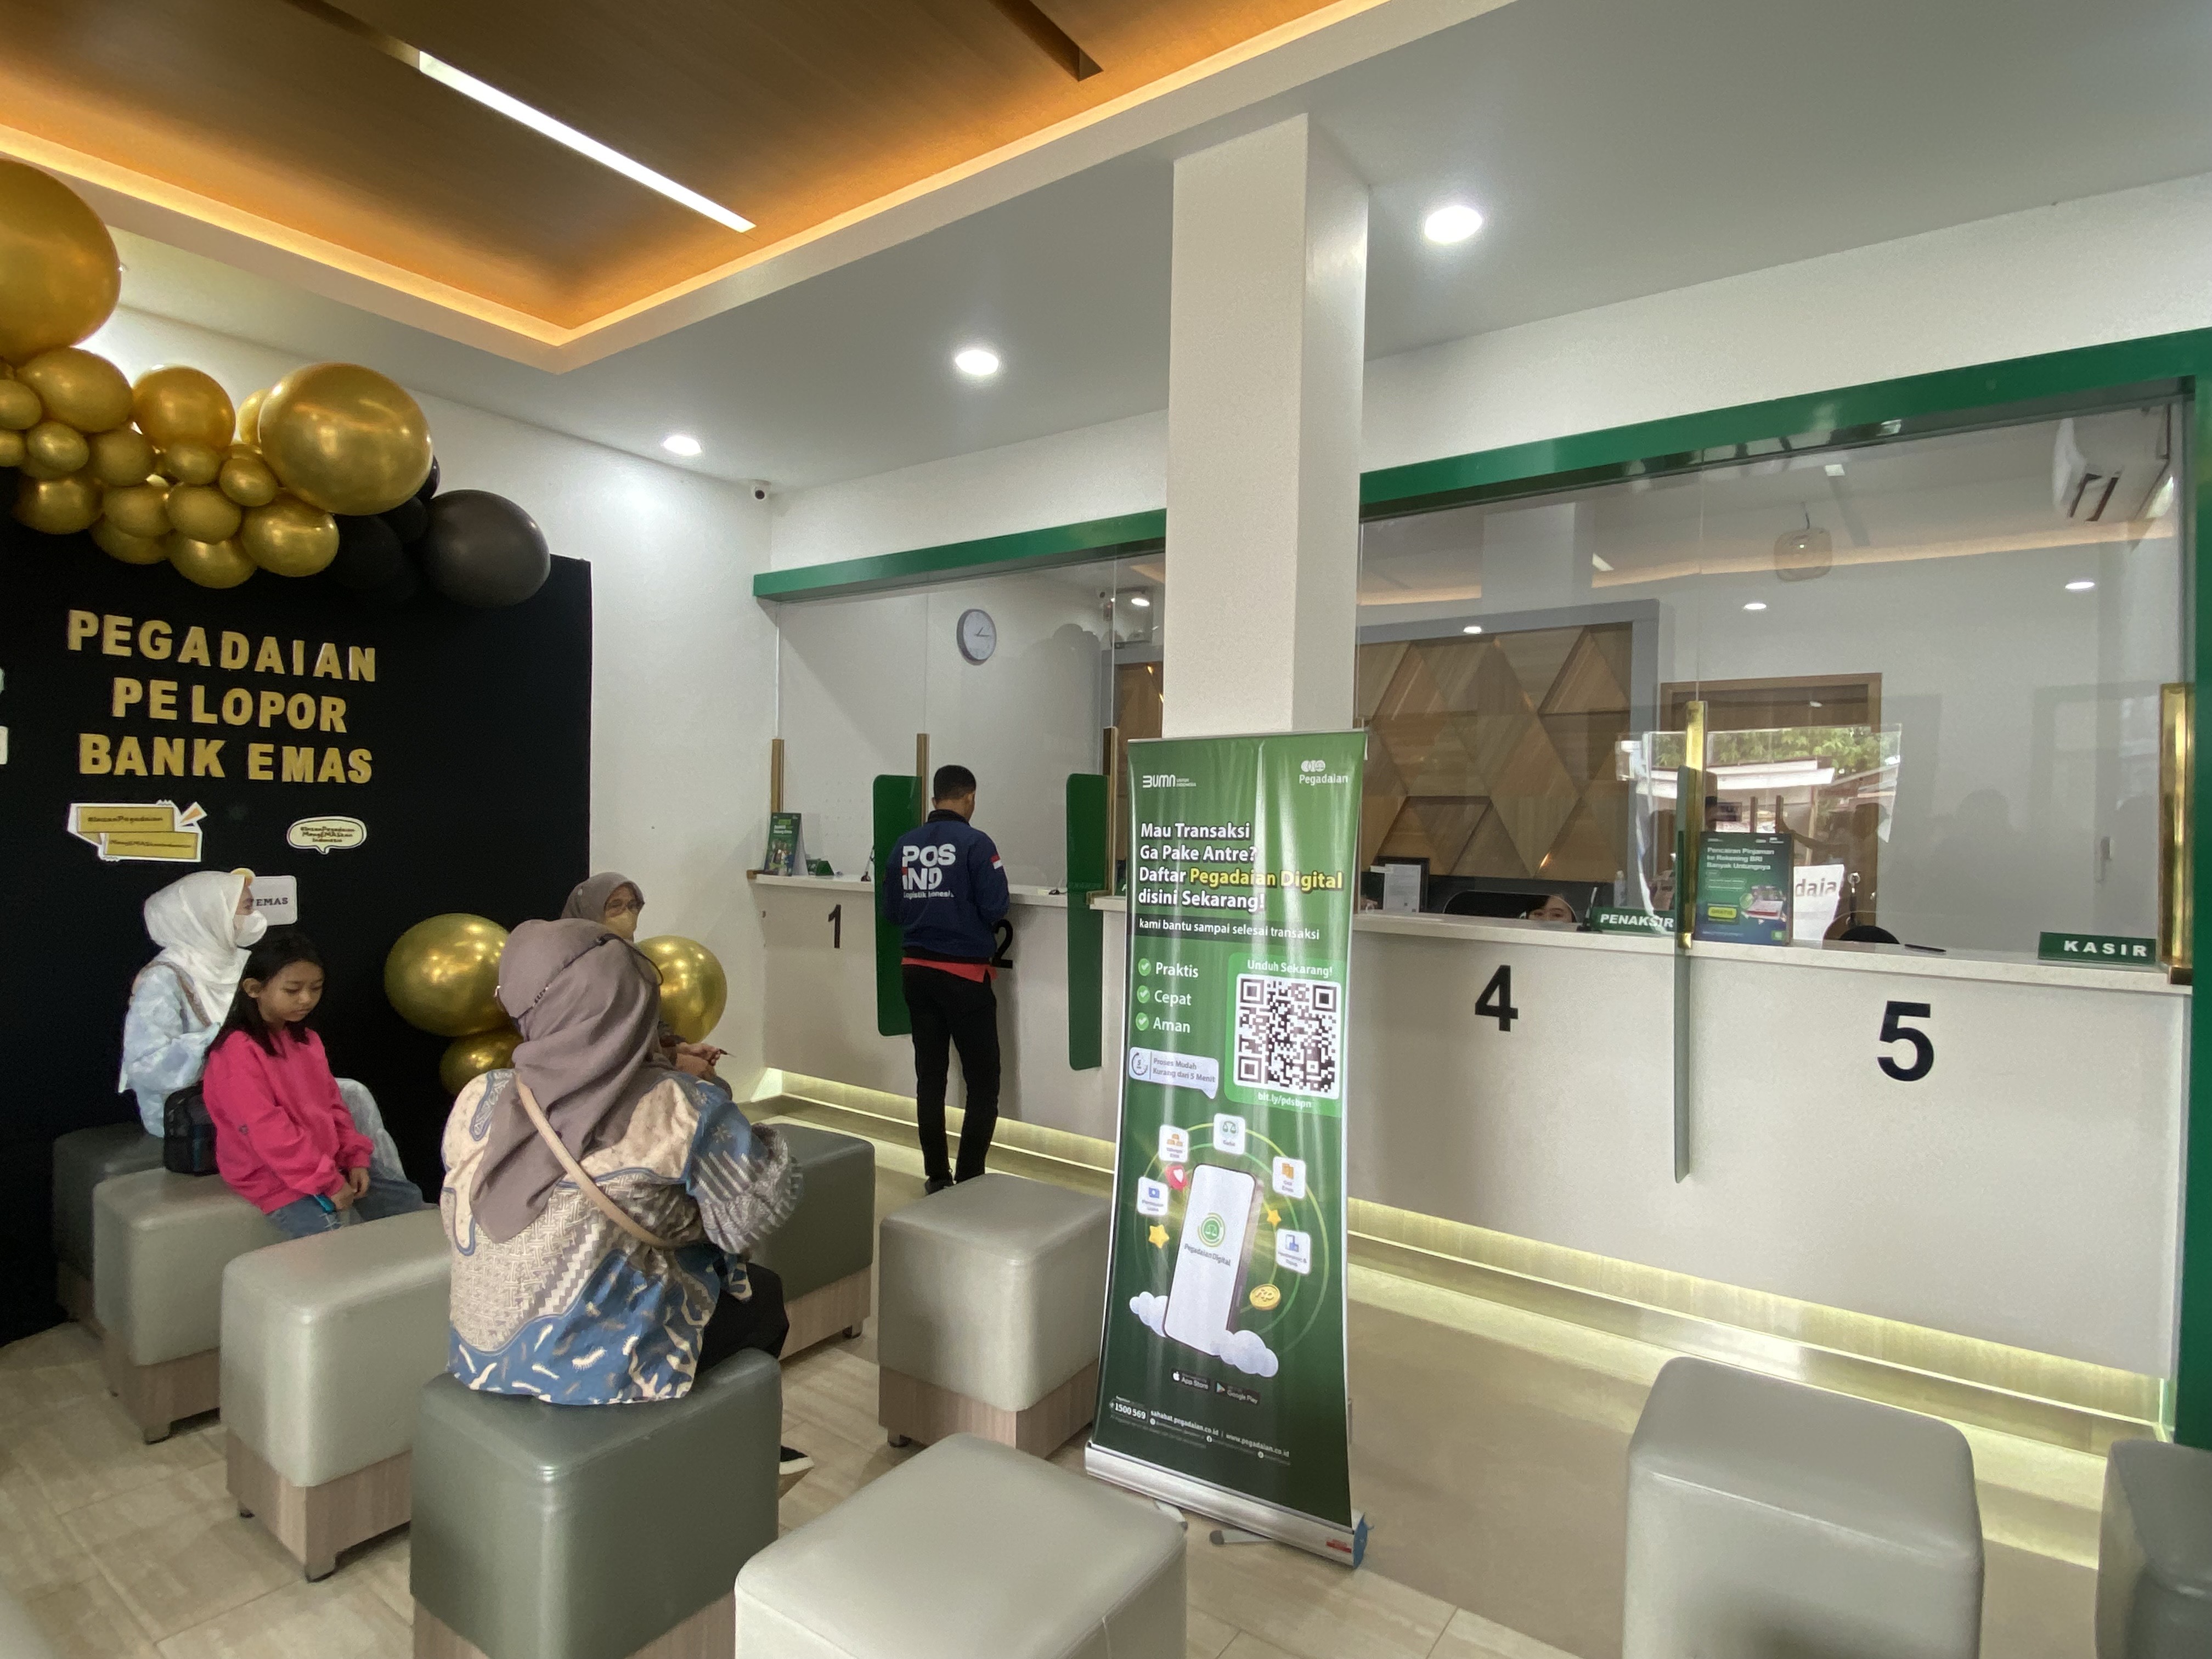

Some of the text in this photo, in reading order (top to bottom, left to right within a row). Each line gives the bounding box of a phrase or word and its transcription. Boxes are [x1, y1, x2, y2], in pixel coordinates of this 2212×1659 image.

[68, 610, 375, 682] PEGADAIAN
[111, 677, 347, 733] PELOPOR
[78, 733, 373, 783] BANK EMAS
[1299, 774, 1348, 786] Pegadaian
[1141, 822, 1250, 839] Mau Transaksi
[902, 843, 956, 867] POS
[1140, 845, 1257, 862] Ga Pake Antre?
[1139, 866, 1343, 891] Daftar Pegadaian Digital
[1138, 889, 1266, 913] disini Sekarang!
[828, 904, 841, 949] 1
[1139, 918, 1320, 940] kami bantu sampai selesai transaksi
[1600, 913, 1674, 928] PENAKSIR
[990, 918, 1013, 969] 2
[2063, 940, 2148, 957] KASIR
[1155, 962, 1199, 978] Praktis
[1248, 959, 1333, 979] Unduh Sekarang!
[1154, 990, 1192, 1007] Cepat
[1475, 964, 1519, 1031] 4
[1153, 1017, 1190, 1034] Aman
[1877, 1000, 1934, 1082] 5
[1153, 1057, 1197, 1070] Proses Mudah
[1153, 1067, 1176, 1077] Kurang
[1177, 1071, 1189, 1079] dari
[1196, 1074, 1216, 1082] Menit
[1258, 1091, 1312, 1111] bit.ly/pdsbpn
[1184, 1243, 1231, 1266] Pegadaian Digital
[1115, 1403, 1147, 1420] 1500 569
